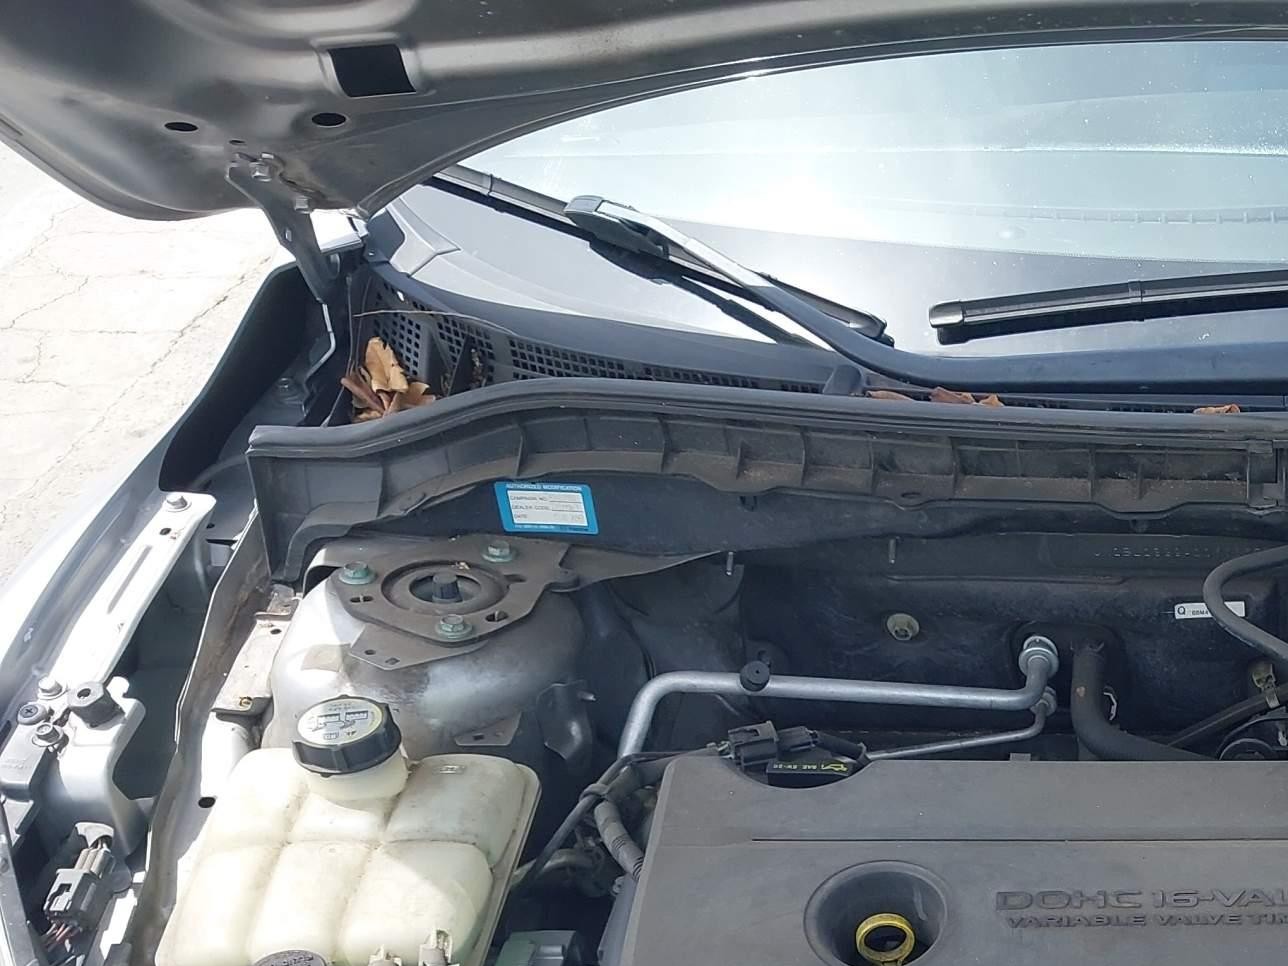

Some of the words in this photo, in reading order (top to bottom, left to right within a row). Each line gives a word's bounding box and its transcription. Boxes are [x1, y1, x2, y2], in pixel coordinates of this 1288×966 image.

[996, 890, 1142, 910] DOHC
[1007, 914, 1147, 928] VARIABLE
[1157, 913, 1242, 926] VALVE
